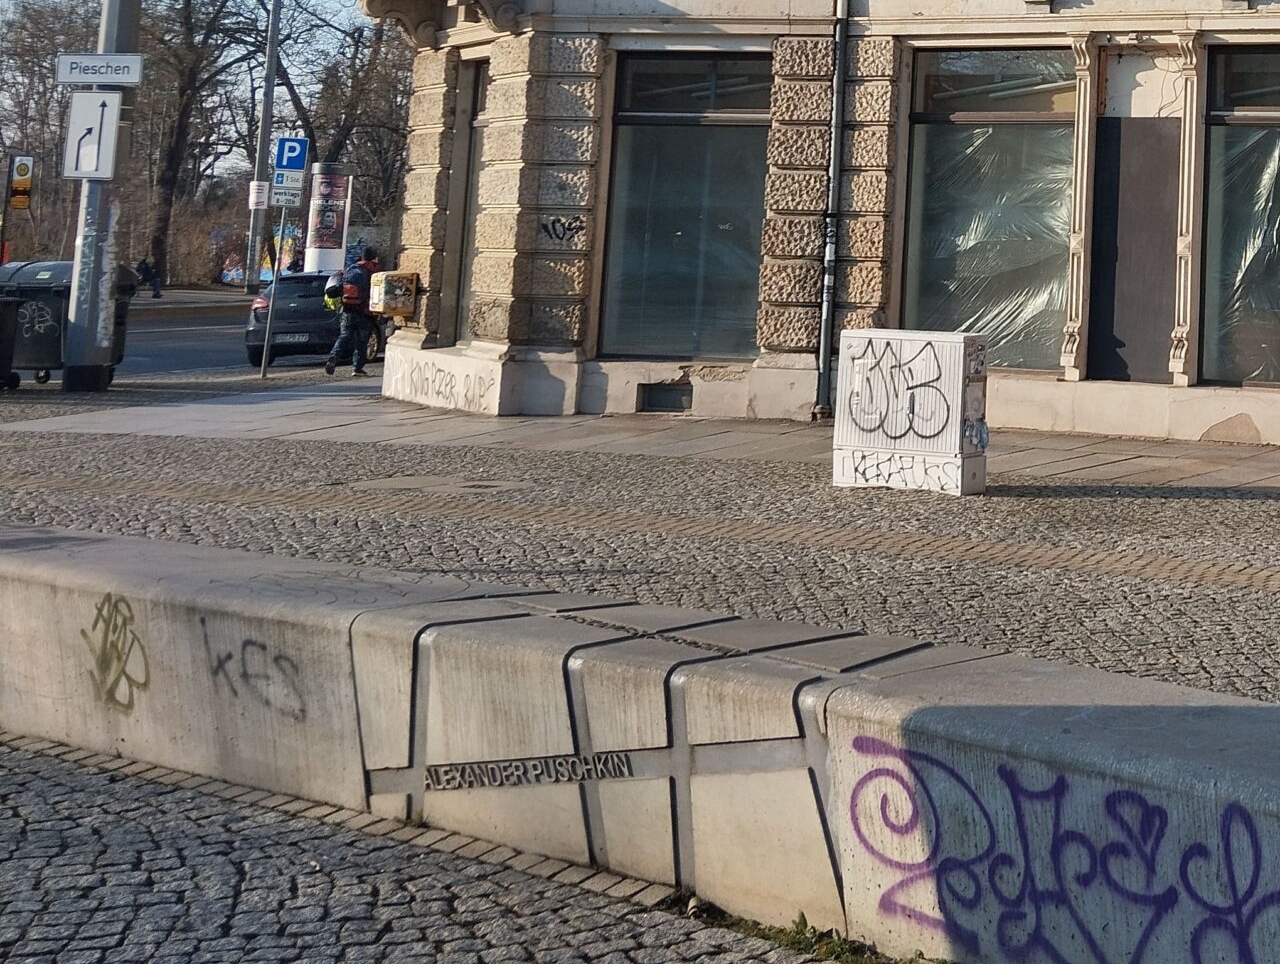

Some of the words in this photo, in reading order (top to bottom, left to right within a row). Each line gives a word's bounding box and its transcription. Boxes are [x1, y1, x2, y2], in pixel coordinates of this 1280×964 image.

[69, 61, 130, 75] Pieschen
[282, 141, 301, 166] P
[273, 190, 300, 198] werktags
[423, 761, 528, 790] ALEXANDER
[531, 751, 633, 784] PUSCHKIN
